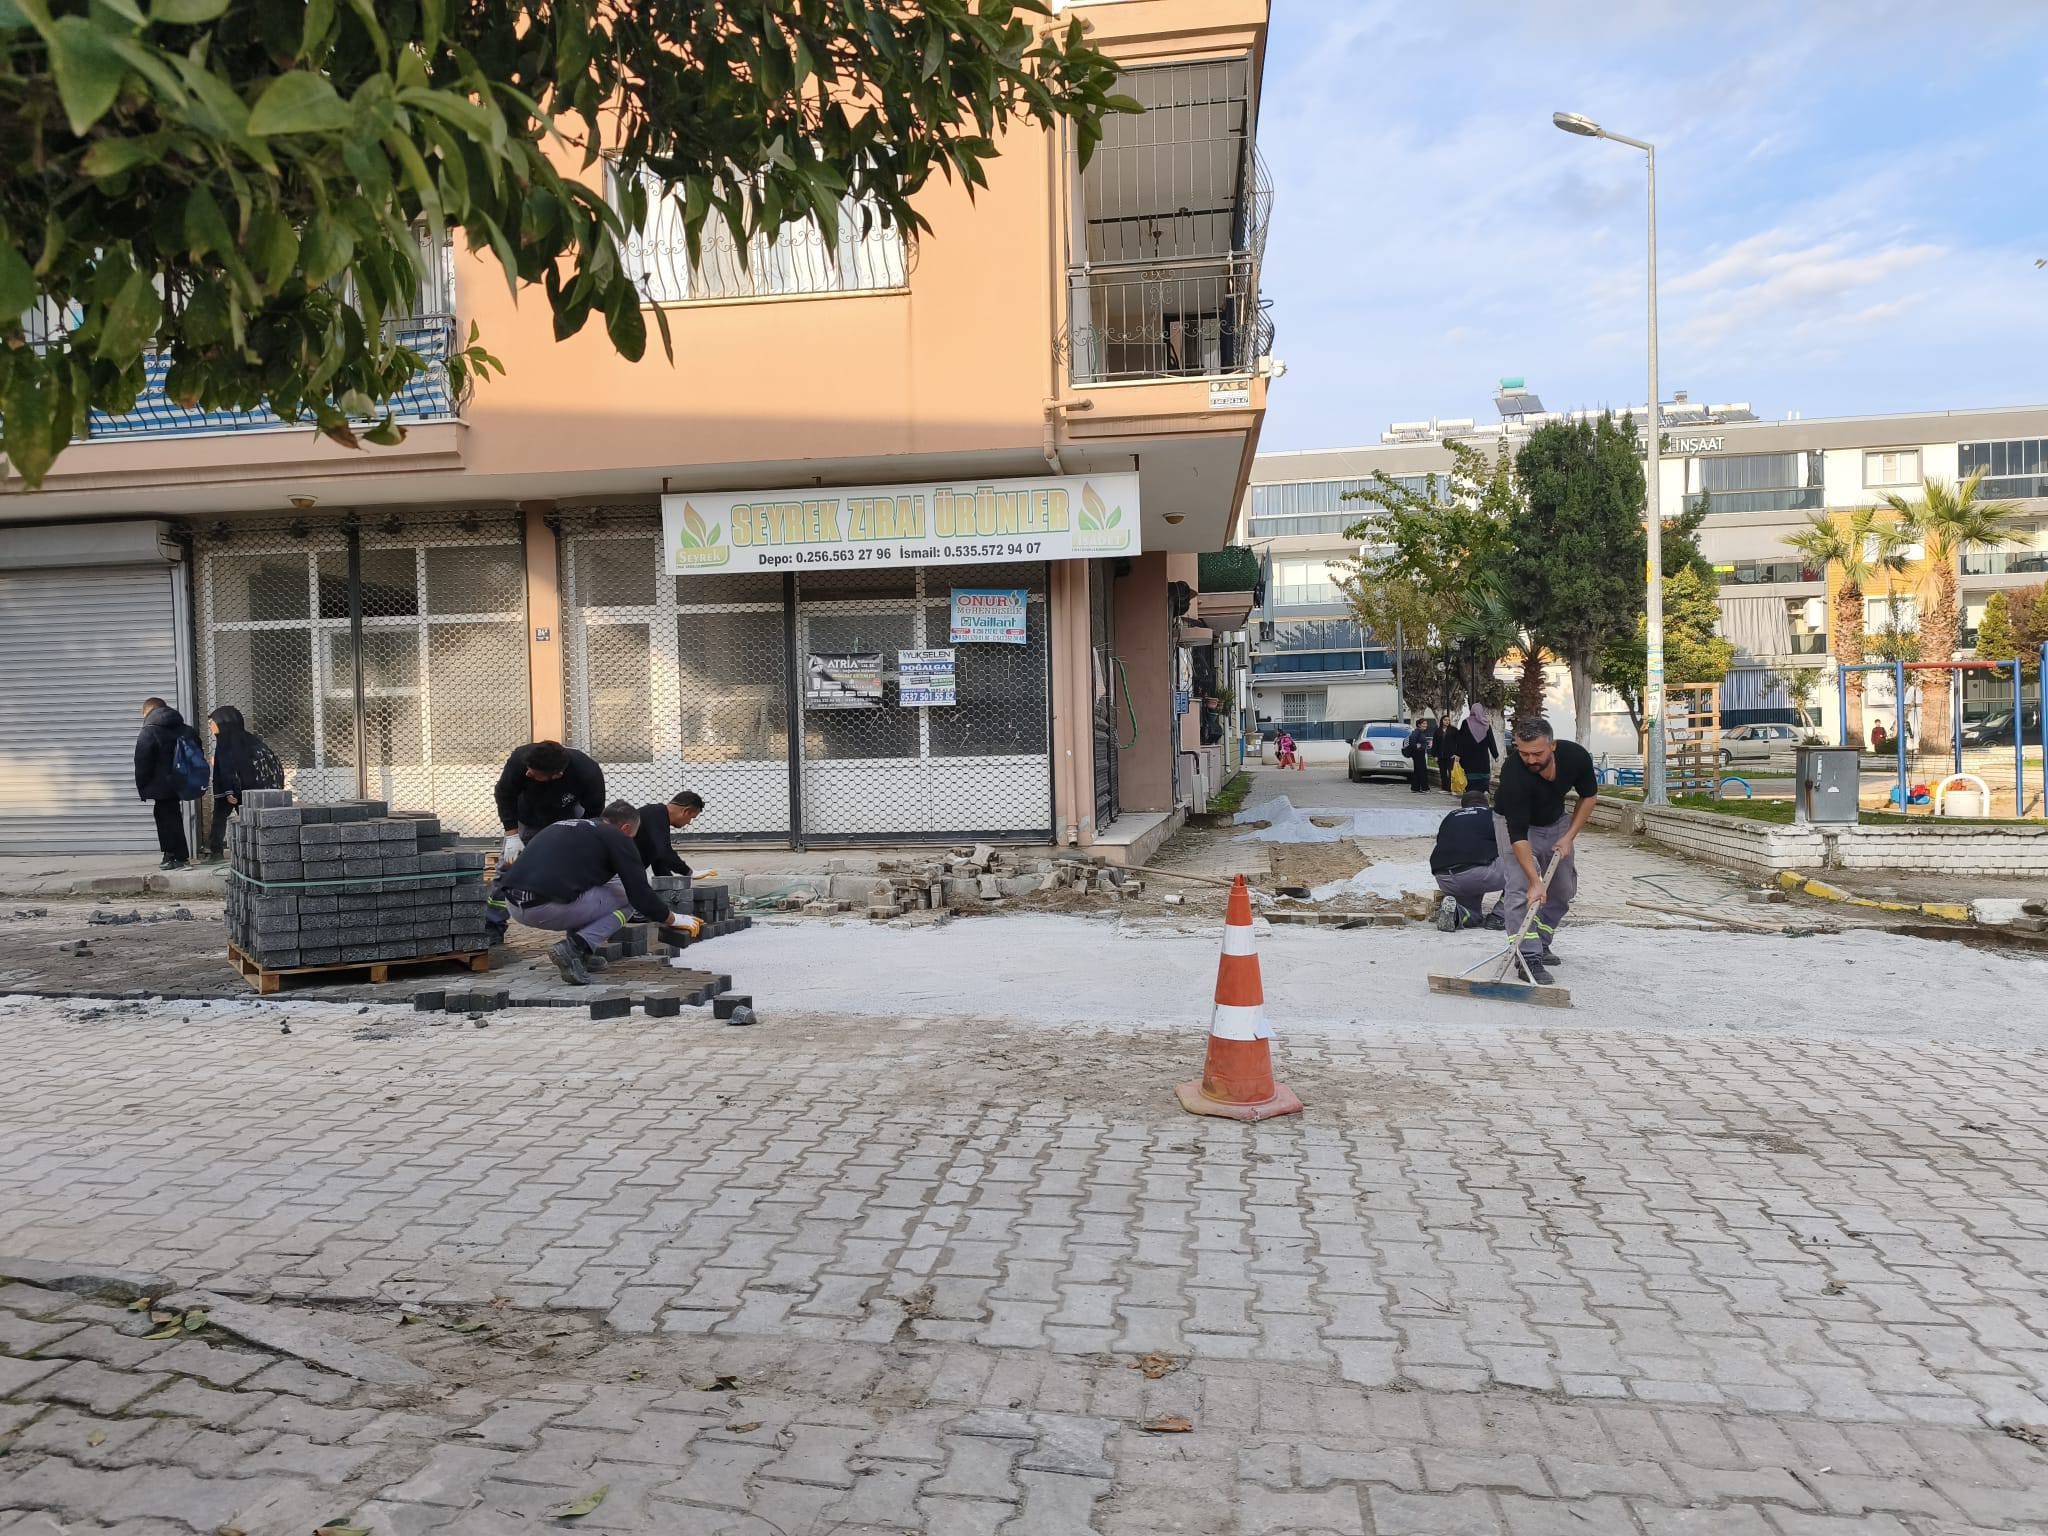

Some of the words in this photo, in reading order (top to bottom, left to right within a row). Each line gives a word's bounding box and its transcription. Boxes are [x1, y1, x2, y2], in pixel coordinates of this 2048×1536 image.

[731, 499, 842, 547] SEYREK
[934, 486, 1070, 538] ÜRÜNLER
[758, 553, 793, 567] Depo:
[796, 549, 854, 564] 0.256.563
[858, 549, 872, 561] 27
[876, 548, 891, 560] 96
[899, 545, 940, 559] İsmail:
[944, 543, 1003, 558] 0.535.572
[1007, 543, 1023, 555] 94
[1026, 542, 1041, 554] 07
[958, 595, 1008, 607] ONUR
[972, 617, 1016, 627] Vaillant
